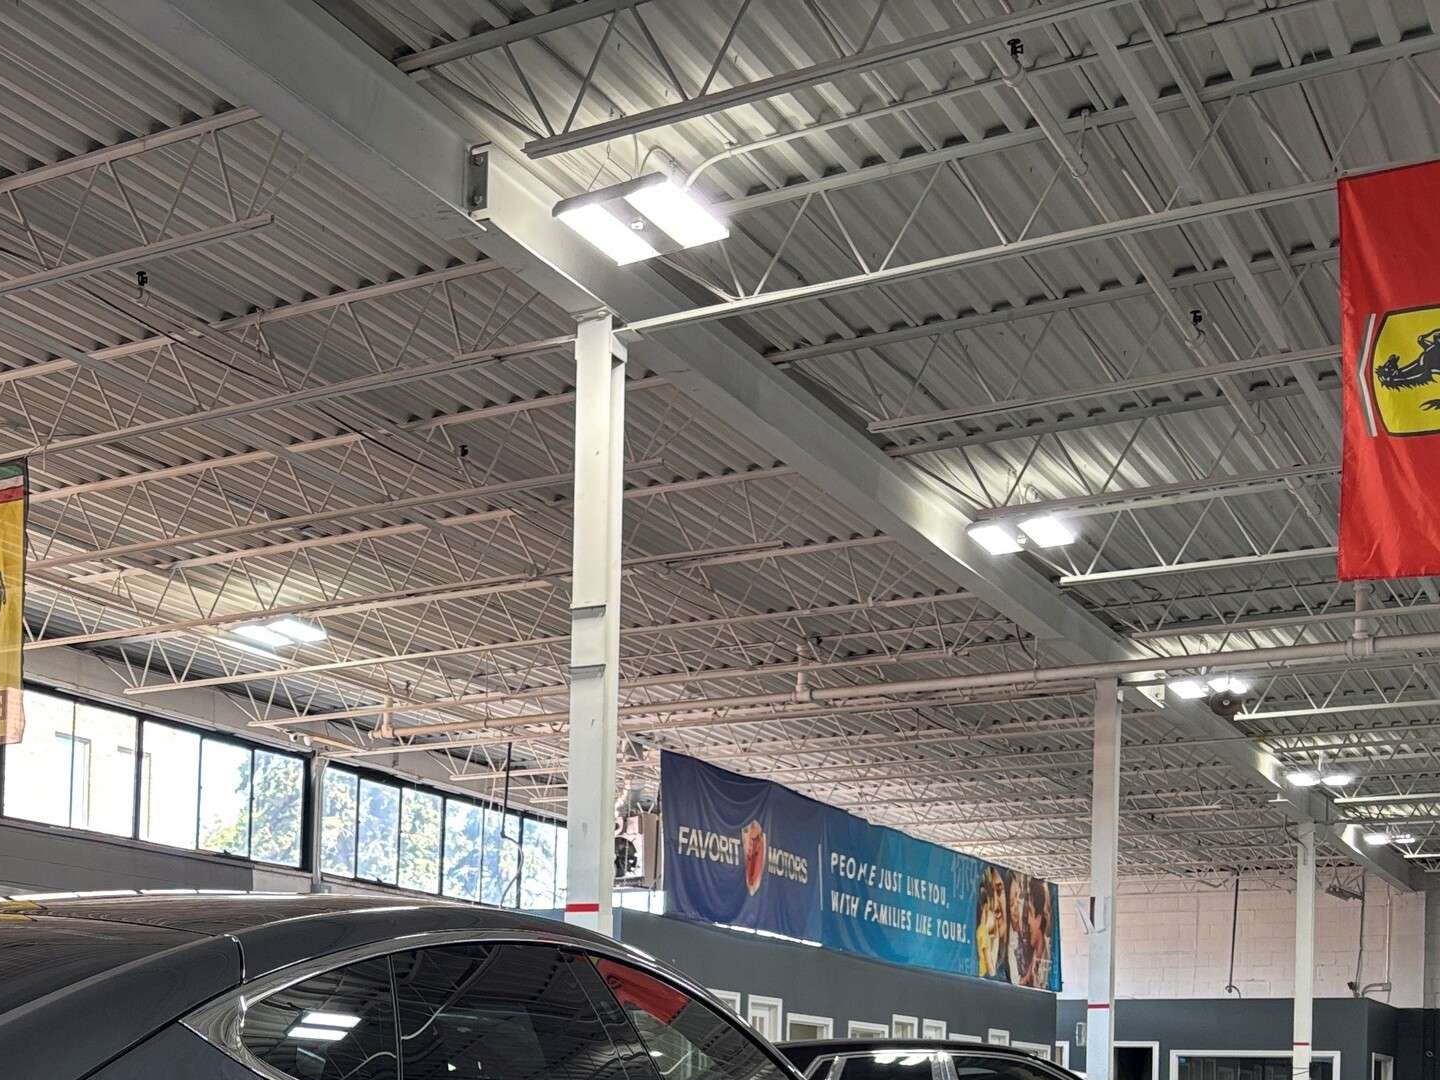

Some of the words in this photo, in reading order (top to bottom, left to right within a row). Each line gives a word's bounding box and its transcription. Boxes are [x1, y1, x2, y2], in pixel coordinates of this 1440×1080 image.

[678, 826, 741, 866] FAVORIT
[768, 846, 808, 884] MOTORS
[878, 868, 903, 893] JUST
[907, 875, 927, 900] LIKE
[830, 890, 860, 918] WITH
[915, 913, 933, 937] LIKE
